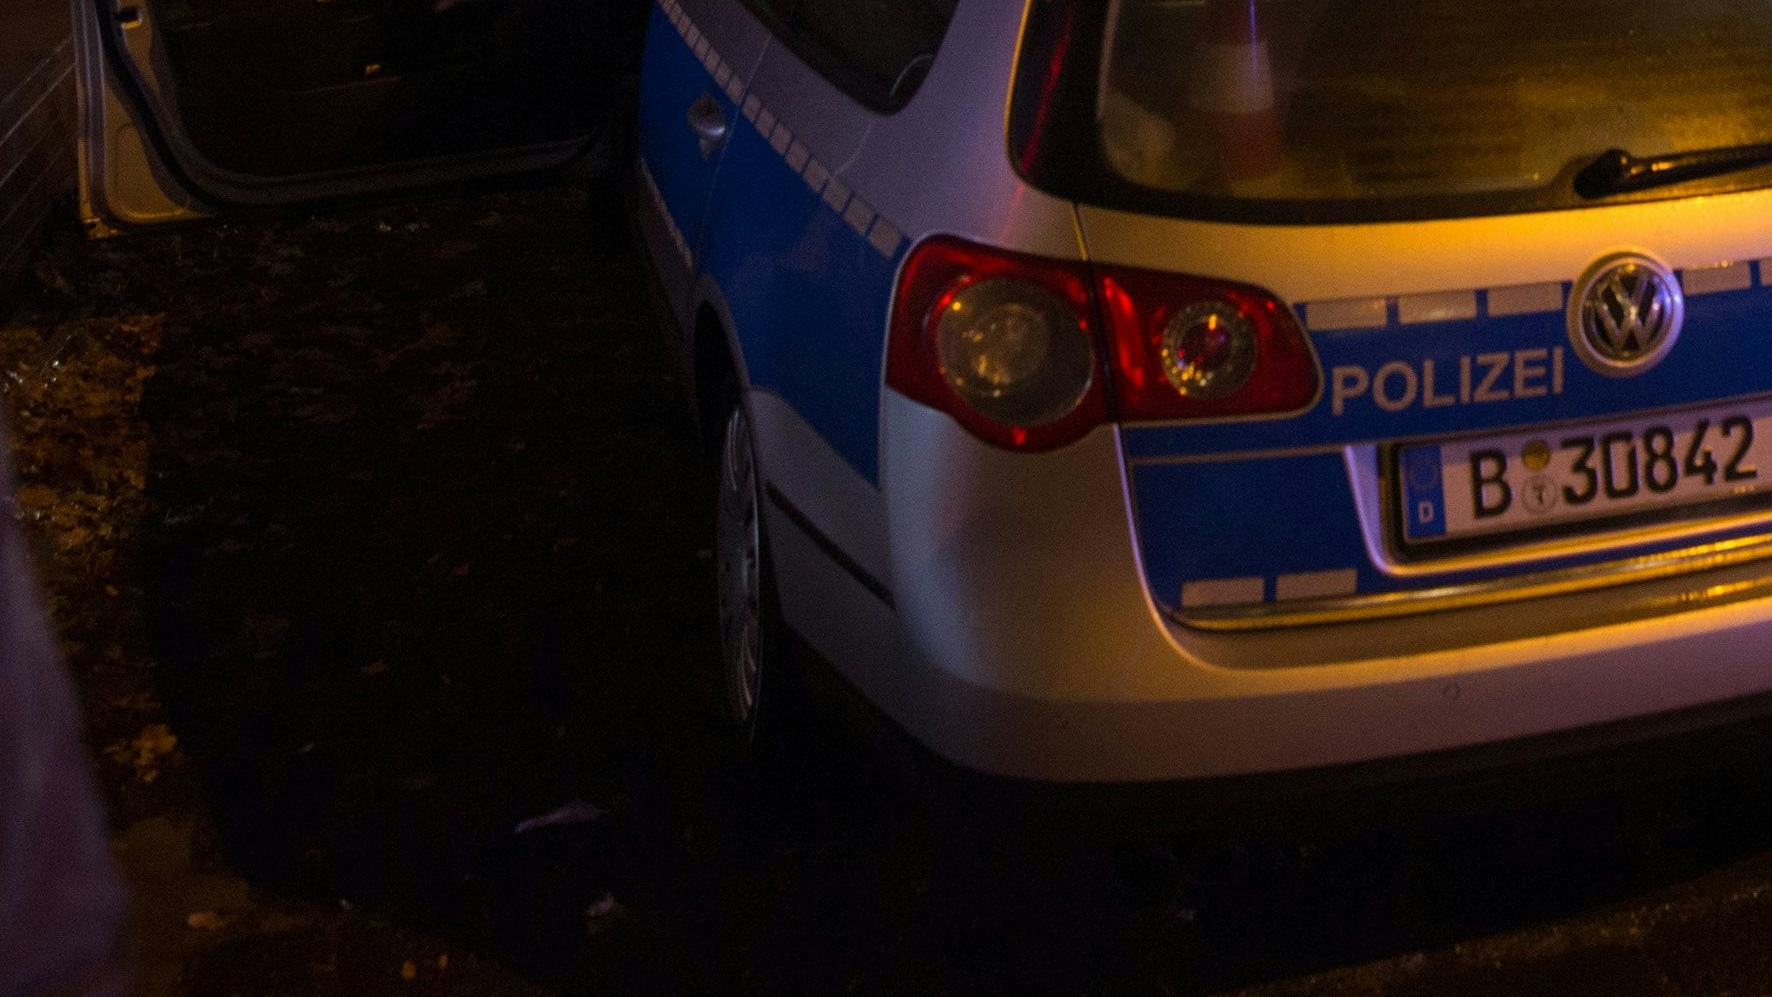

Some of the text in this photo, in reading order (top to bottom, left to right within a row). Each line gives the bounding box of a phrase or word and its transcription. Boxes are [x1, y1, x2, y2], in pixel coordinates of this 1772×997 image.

[1330, 346, 1565, 418] POLIZEI
[1418, 414, 1758, 524] D B 30842
